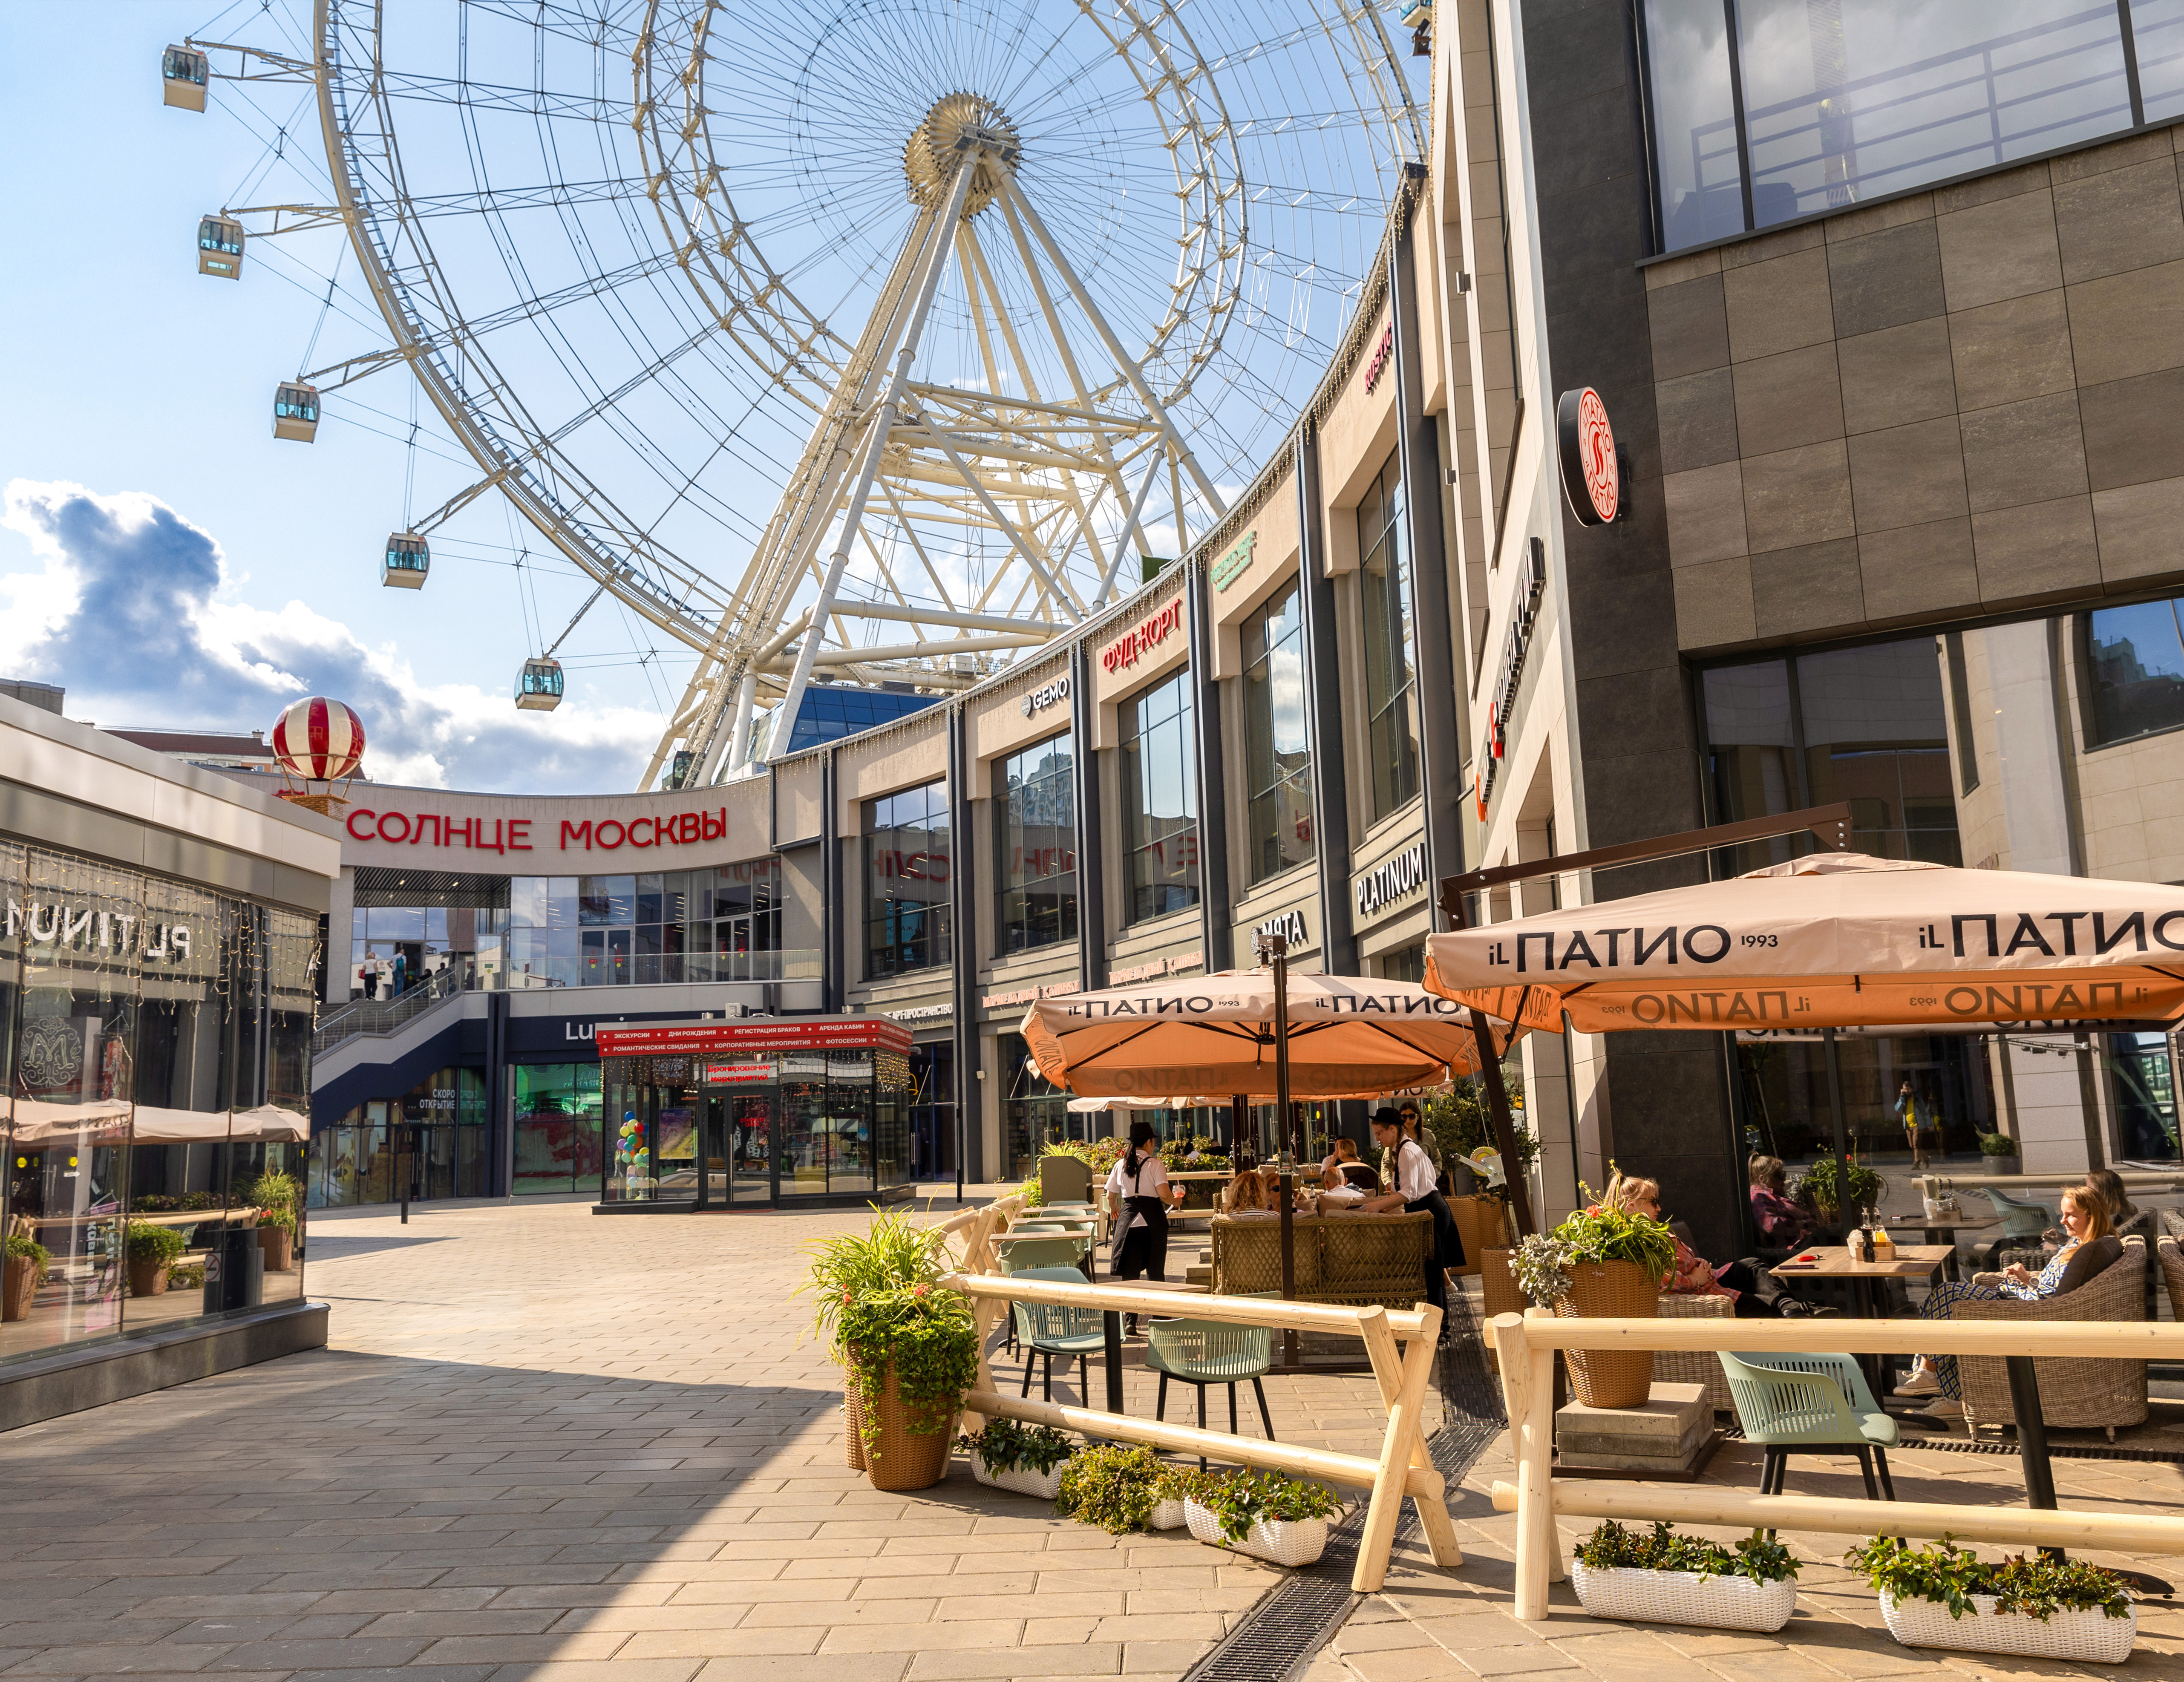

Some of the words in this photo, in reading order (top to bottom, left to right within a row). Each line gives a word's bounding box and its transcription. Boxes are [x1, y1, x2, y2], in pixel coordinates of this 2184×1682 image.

[1103, 598, 1181, 673] ФУД-КОРТ
[1033, 677, 1068, 709] GEMO
[346, 809, 533, 855] СОЛНЦЕ
[560, 807, 726, 850] МОСКВЫ
[1357, 842, 1423, 916] PLATINUM
[1919, 924, 1945, 949] iL
[1951, 910, 2184, 957] ПАТИО
[1489, 942, 1510, 966] iL
[1517, 925, 1732, 973] ПАТИО
[1741, 934, 1778, 948] 1993
[1108, 957, 1166, 985] МАРМЕЛАДНЫЙ
[1166, 950, 1203, 973] КАПИТАН
[982, 984, 1040, 1008] МАРМЕЛАДНЫЙ
[1042, 979, 1080, 999] КАПИТАН
[1068, 1005, 1082, 1017] iL
[1085, 996, 1213, 1019] ПАТИО
[1315, 998, 1329, 1008] iL
[1332, 995, 1461, 1014] ПАТИО
[892, 1003, 953, 1020] АРТ-ПРОСТРАНСТВО
[707, 1064, 770, 1073] Бронирование
[710, 1074, 768, 1083] мероприятий
[419, 1099, 455, 1109] ОТКРЫТИЕ
[432, 1088, 455, 1098] СКОРО
